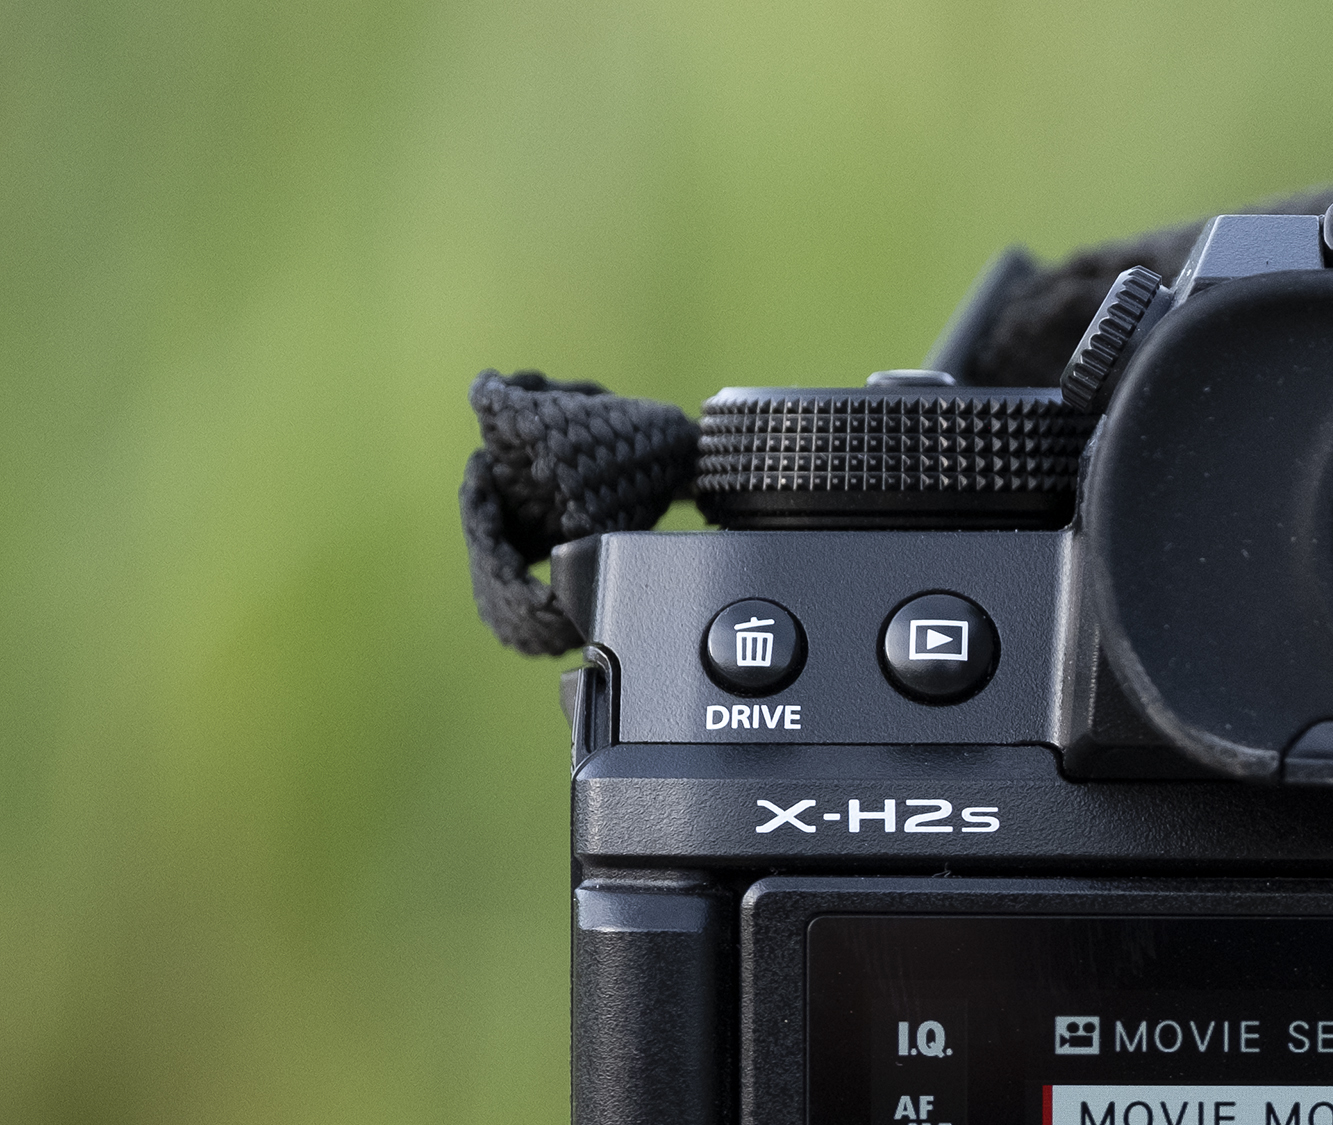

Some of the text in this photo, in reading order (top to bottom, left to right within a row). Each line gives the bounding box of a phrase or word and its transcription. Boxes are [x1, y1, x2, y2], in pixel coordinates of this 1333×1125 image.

[705, 704, 802, 731] DRIVE
[755, 798, 1000, 834] X-H2s
[898, 1020, 953, 1059] I.Q.
[1115, 1019, 1261, 1053] MOVIE
[893, 1095, 935, 1120] AF
